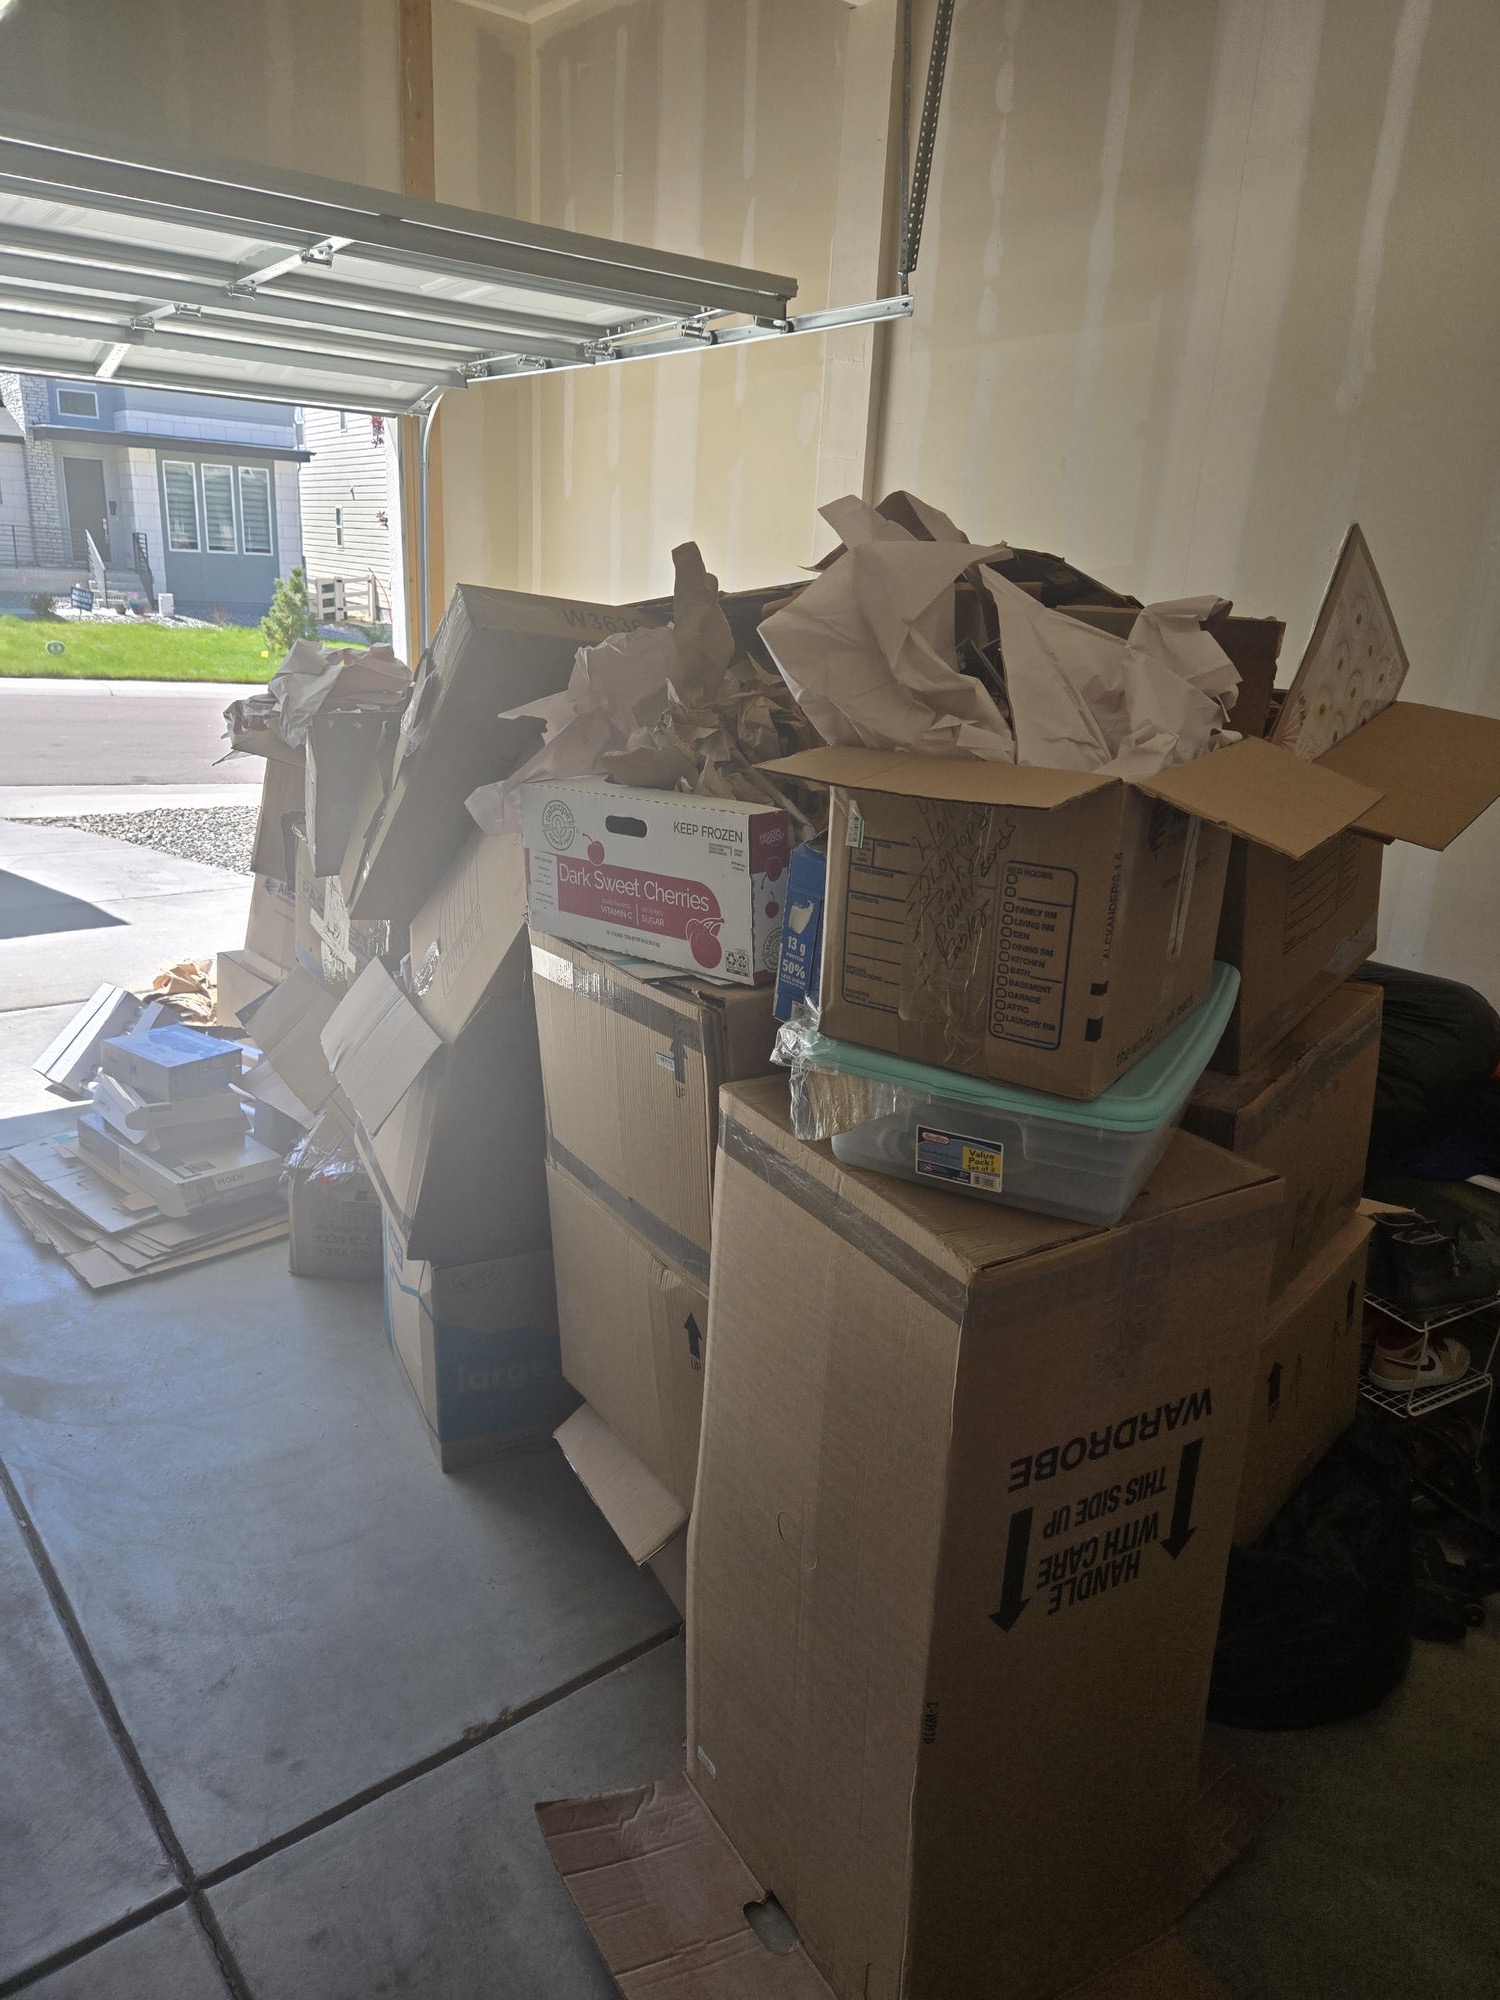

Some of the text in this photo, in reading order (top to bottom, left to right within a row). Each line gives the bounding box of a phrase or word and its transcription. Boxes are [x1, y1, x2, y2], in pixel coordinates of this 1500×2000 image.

[673, 822, 743, 843] KEEP FROZEN
[559, 864, 591, 888] Dark
[594, 870, 641, 898] Sweet
[644, 880, 709, 912] Cherries
[601, 904, 627, 918] VITAMIN
[1015, 906, 1057, 922] FAMILY RM
[641, 914, 665, 928] SUGAR
[1014, 917, 1055, 933] LIVING RM
[1013, 929, 1029, 941] DEN
[788, 936, 806, 957] 13 g
[1012, 942, 1053, 958] DINING RM
[782, 959, 806, 979] 50%
[1010, 954, 1045, 969] KITCHEN
[1010, 966, 1030, 978] BATH
[1008, 978, 1051, 995] BASEMENT
[1007, 990, 1041, 1005] GARAGE
[1005, 1003, 1028, 1015] ATTIC
[1005, 1014, 1056, 1033] LAUNDRY RM
[1116, 1047, 1131, 1067] the
[968, 1157, 994, 1167] Pack!
[969, 1149, 995, 1160] Value
[217, 1174, 244, 1185] MOEN
[1008, 1387, 1213, 1493] WARDROBE
[1042, 1466, 1167, 1540] THIS SIDE UP
[1035, 1511, 1160, 1590] WITH CARE
[1046, 1549, 1142, 1616] HANDLE
